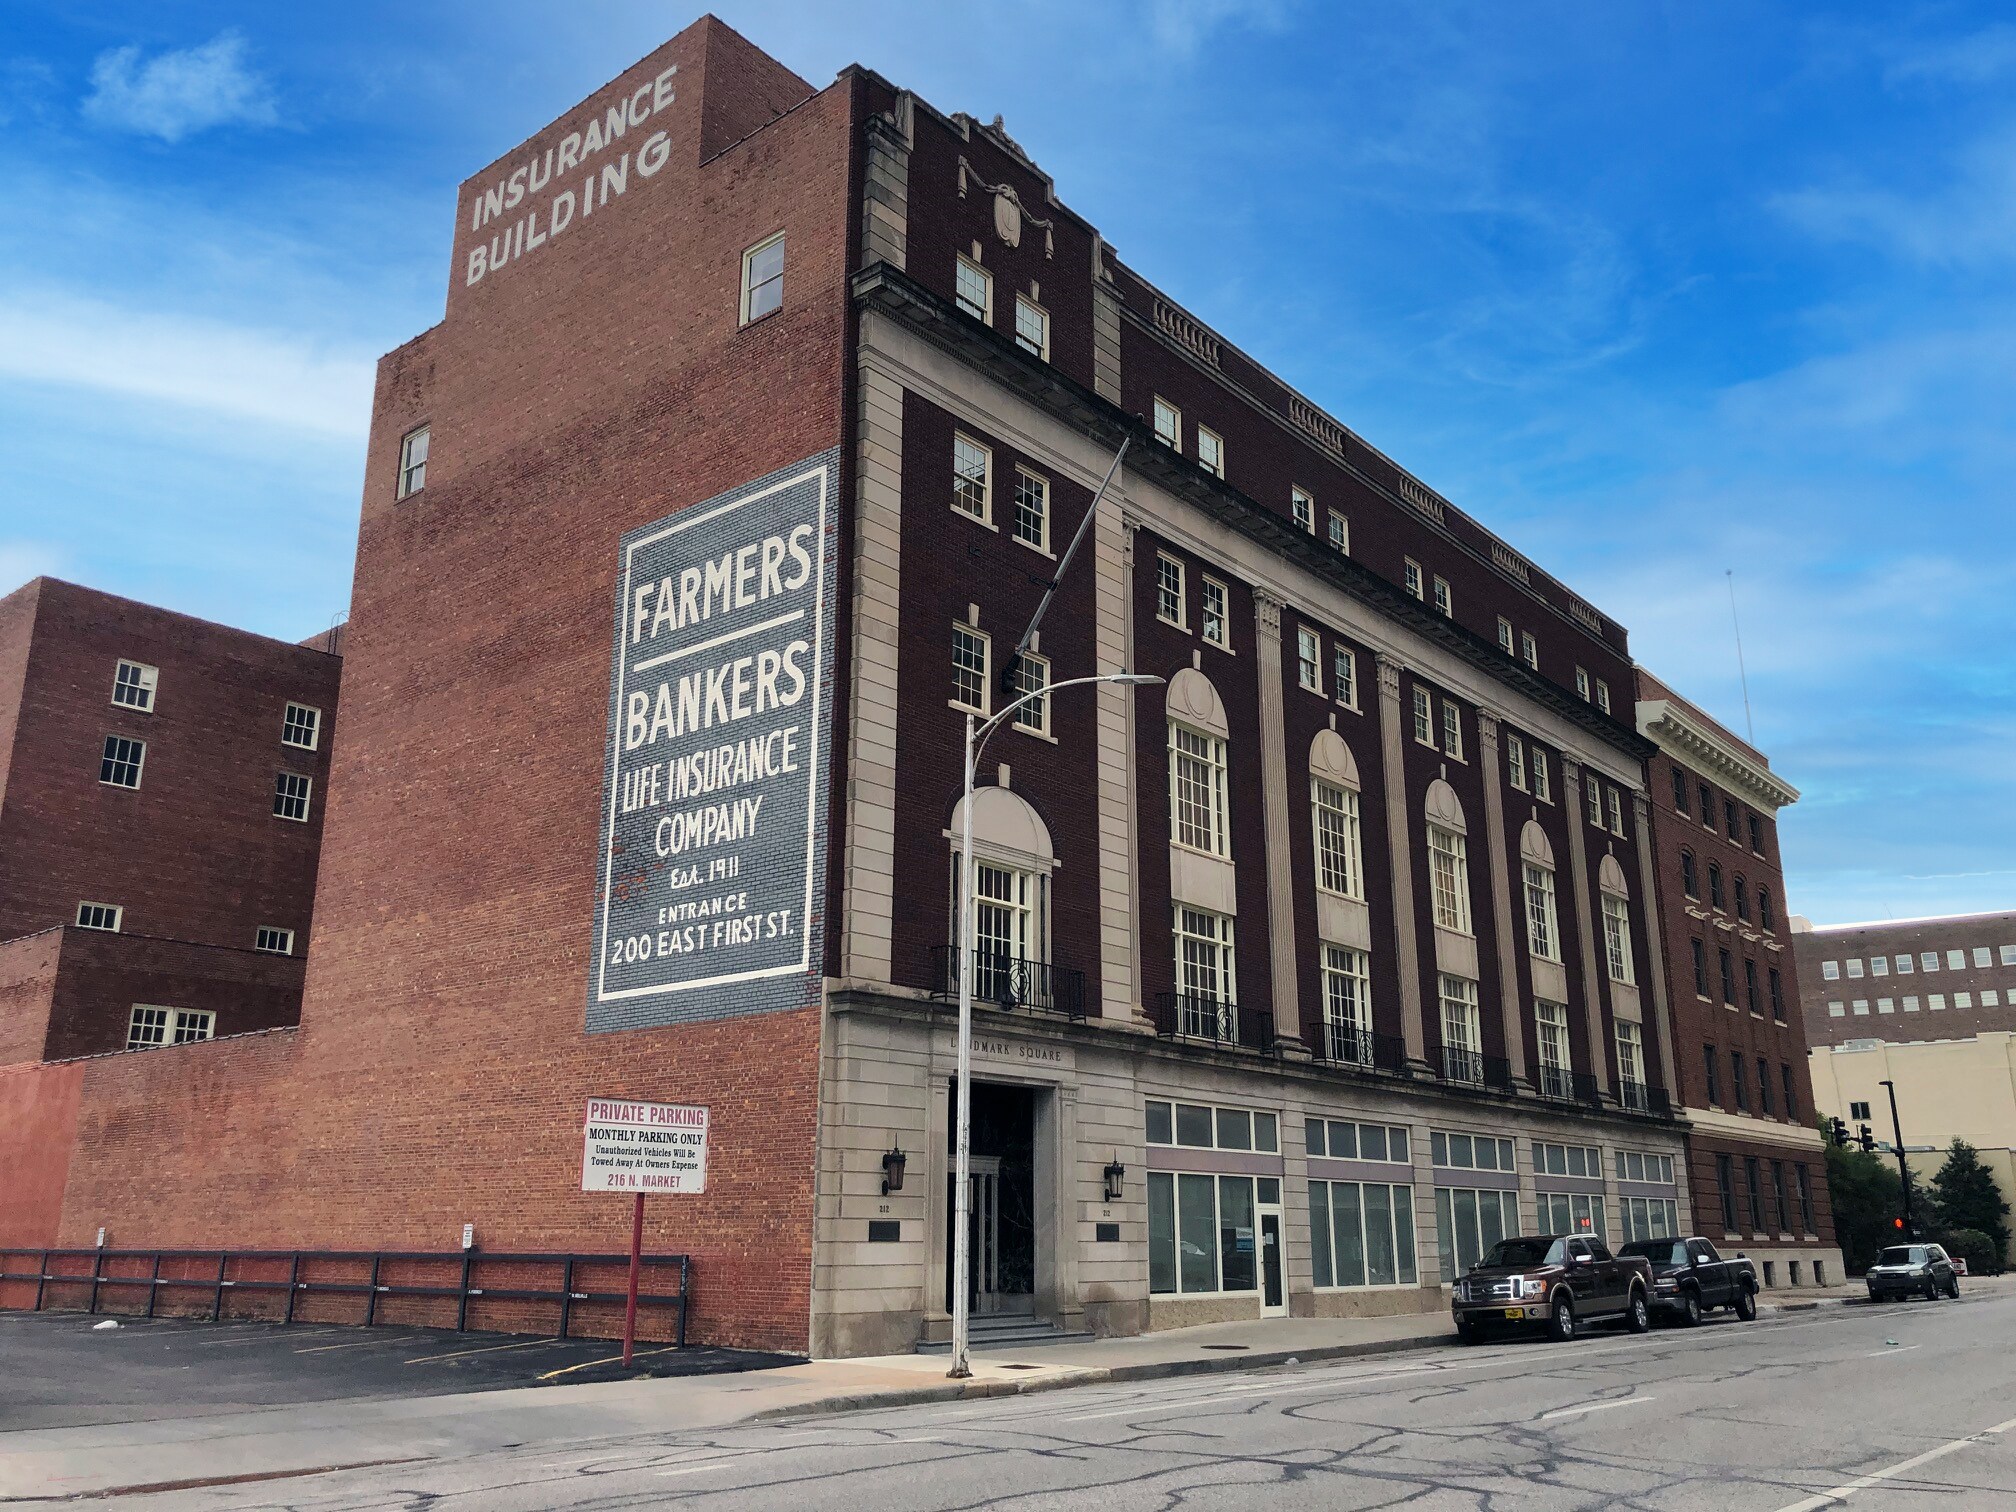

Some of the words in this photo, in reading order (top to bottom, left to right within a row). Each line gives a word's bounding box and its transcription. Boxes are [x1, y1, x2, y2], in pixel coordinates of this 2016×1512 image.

[472, 65, 677, 232] INSURANCE
[466, 131, 671, 287] BUILDING
[633, 524, 813, 643] FARMERS
[626, 640, 809, 750] BANKERS
[622, 763, 662, 813] LIFE
[667, 726, 799, 802] INSURANCE
[656, 795, 763, 857] COMPANY
[671, 867, 703, 889] Est.
[709, 856, 739, 881] 1911
[659, 892, 747, 924] ENTRANCE
[611, 934, 651, 964] 200
[657, 924, 707, 957] EAST
[713, 913, 763, 947] FIRST
[766, 909, 794, 938] ST.
[951, 1037, 1010, 1055] LDMARK
[1019, 1046, 1061, 1062] SQUARE
[590, 1102, 645, 1121] PRIVATE
[650, 1106, 704, 1125] PARKING
[589, 1128, 636, 1141] MONTHLY
[638, 1131, 678, 1144] PARKING
[680, 1133, 703, 1145] ONLY
[595, 1145, 642, 1156] Unauthorized
[644, 1147, 671, 1157] Vehicles
[673, 1149, 686, 1157] Will
[687, 1149, 696, 1158] Be
[591, 1156, 614, 1167] Towed
[615, 1158, 634, 1169] Away
[635, 1159, 643, 1168] At
[645, 1160, 670, 1169] Owners
[671, 1160, 698, 1171] Expense
[607, 1173, 625, 1186] 216
[628, 1174, 638, 1187] N.
[642, 1174, 681, 1187] MARKET
[879, 1205, 890, 1213] 212
